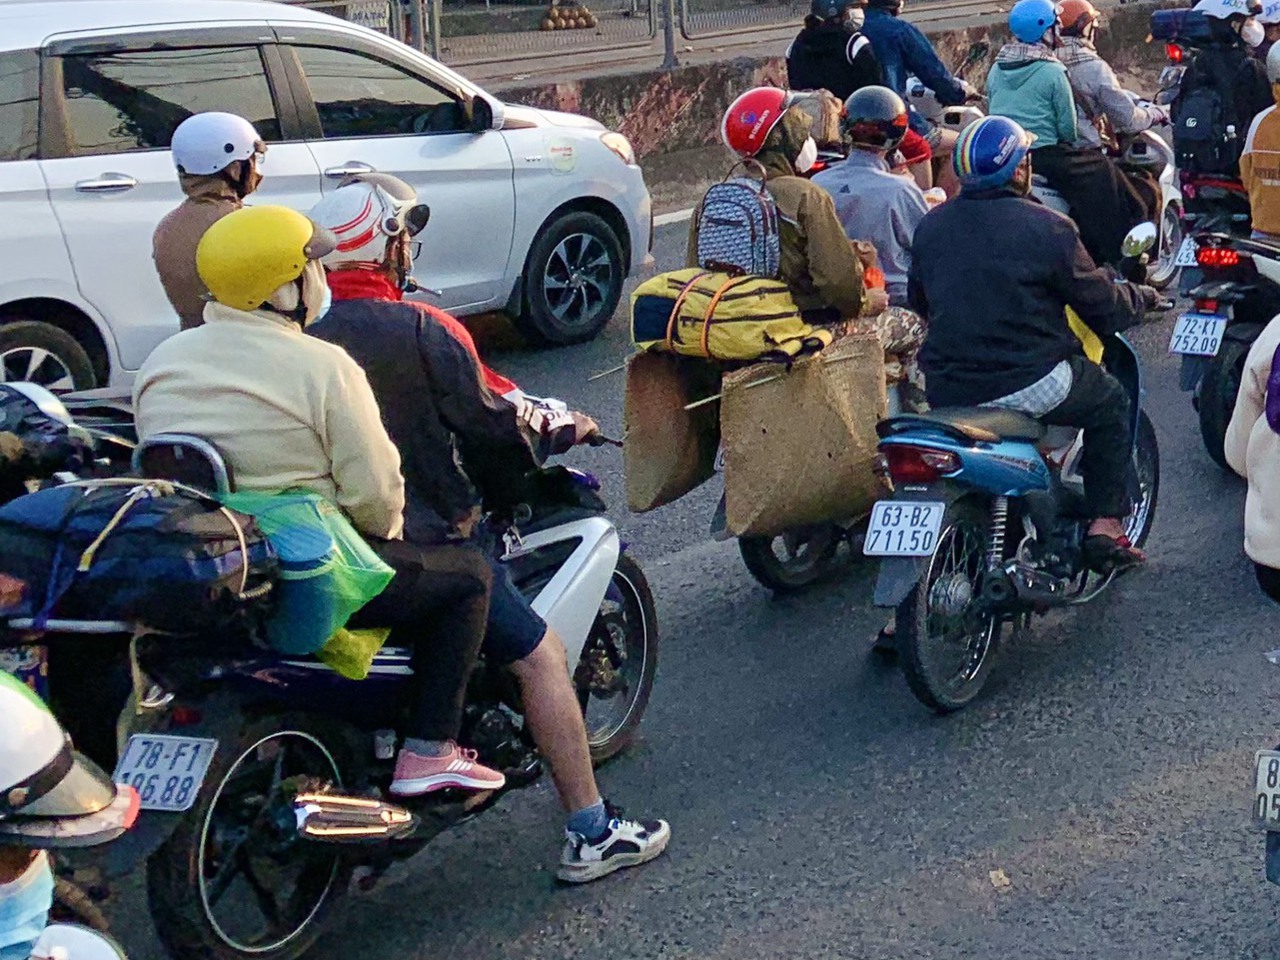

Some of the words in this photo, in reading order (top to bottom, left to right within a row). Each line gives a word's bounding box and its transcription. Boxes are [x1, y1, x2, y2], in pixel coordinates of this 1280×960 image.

[1182, 318, 1217, 336] 72-K1
[1173, 335, 1218, 353] 752.09
[881, 506, 933, 528] 63-B2
[868, 529, 934, 552] 711.50
[134, 740, 202, 772] 78-F1
